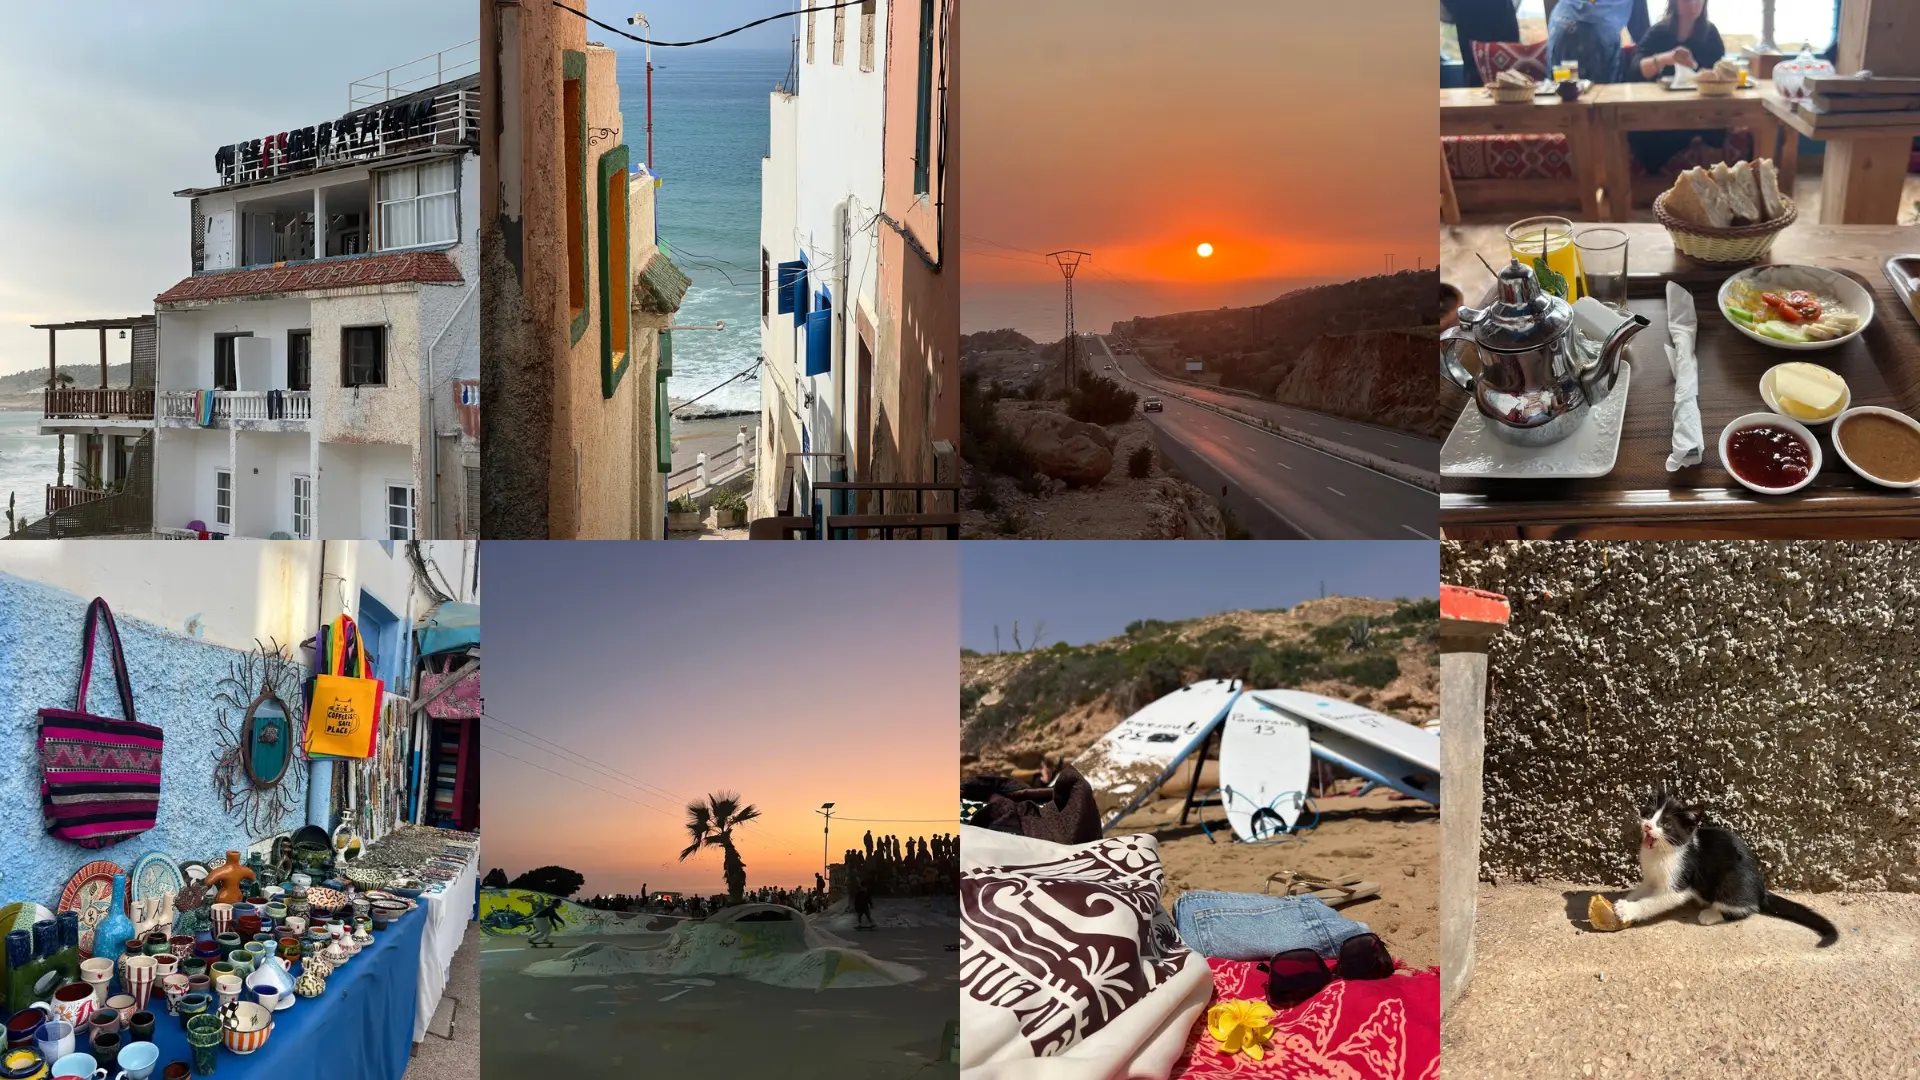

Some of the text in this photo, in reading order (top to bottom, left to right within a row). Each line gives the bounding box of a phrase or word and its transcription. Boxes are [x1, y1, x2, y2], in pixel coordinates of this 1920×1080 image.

[224, 270, 297, 292] COAST
[294, 257, 410, 286] MOROCCO
[327, 725, 348, 734] PLACE
[1253, 725, 1276, 736] 13
